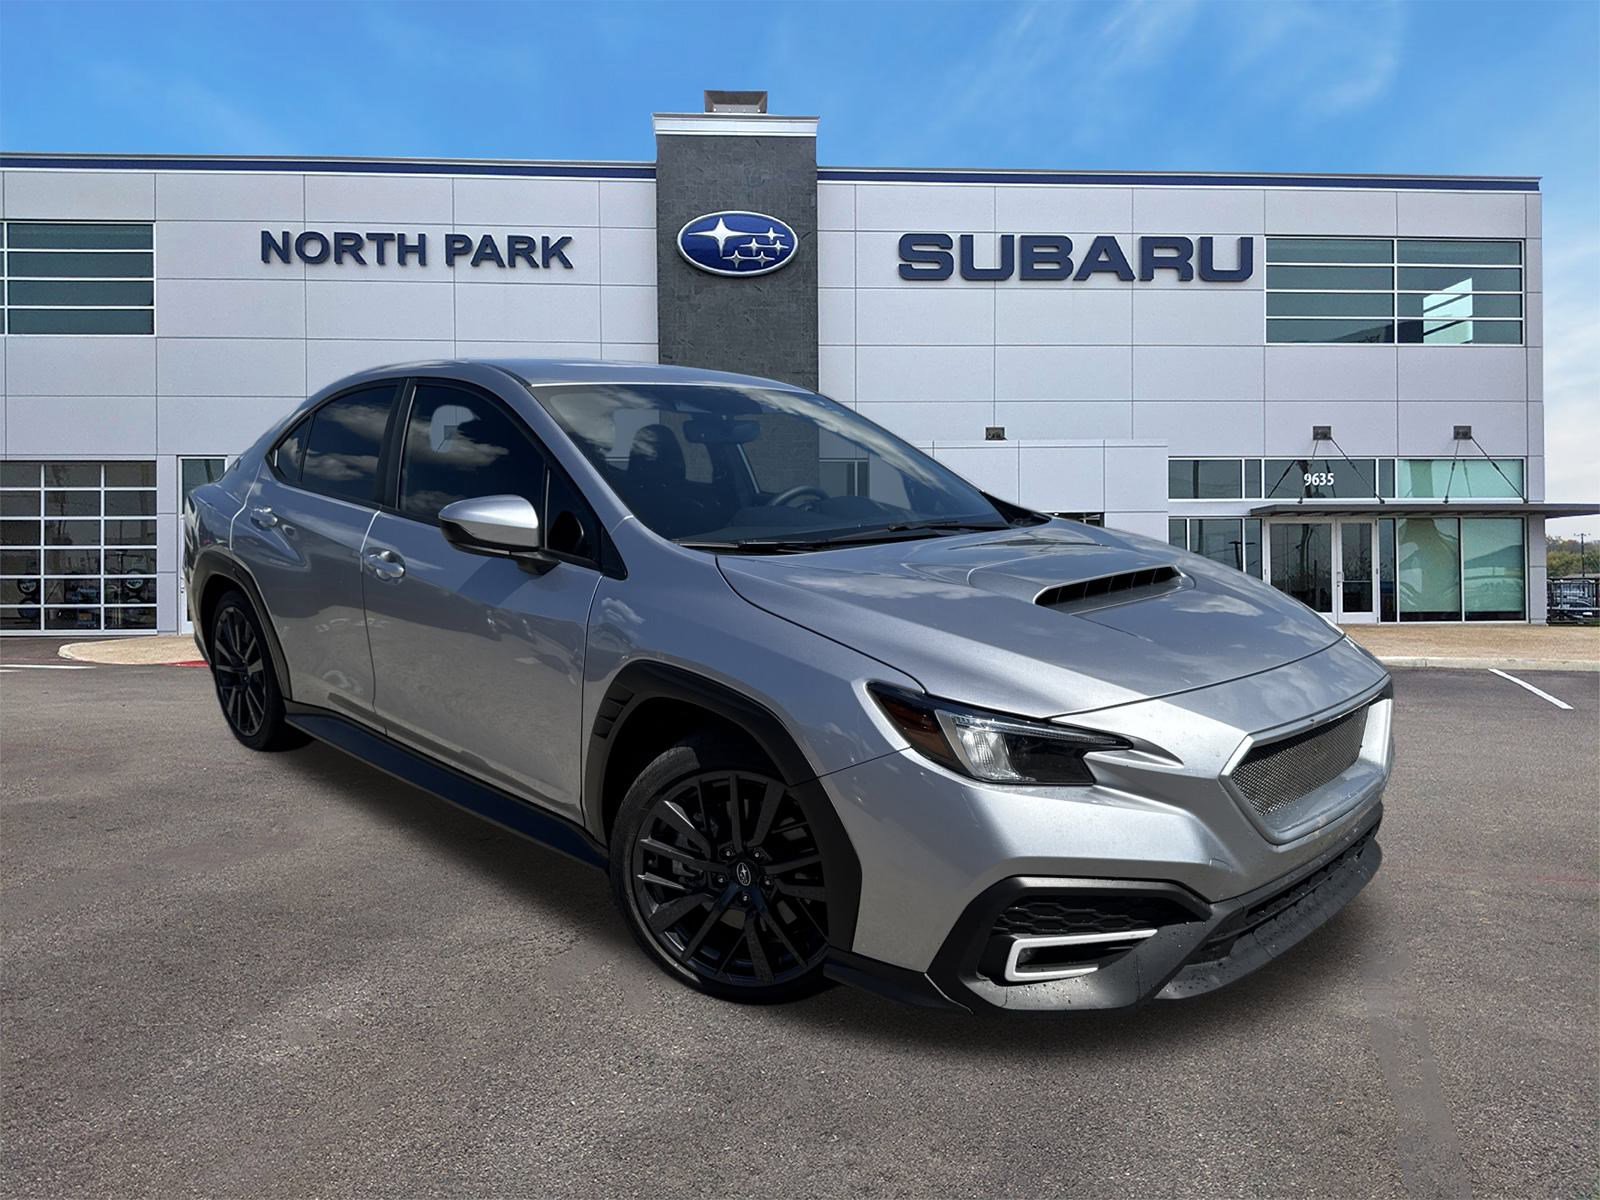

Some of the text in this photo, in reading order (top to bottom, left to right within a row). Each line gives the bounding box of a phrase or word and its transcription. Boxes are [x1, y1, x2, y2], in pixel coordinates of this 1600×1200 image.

[260, 230, 574, 269] NORTH PARK
[898, 233, 1254, 282] SUBARU
[1303, 472, 1335, 487] 9635
